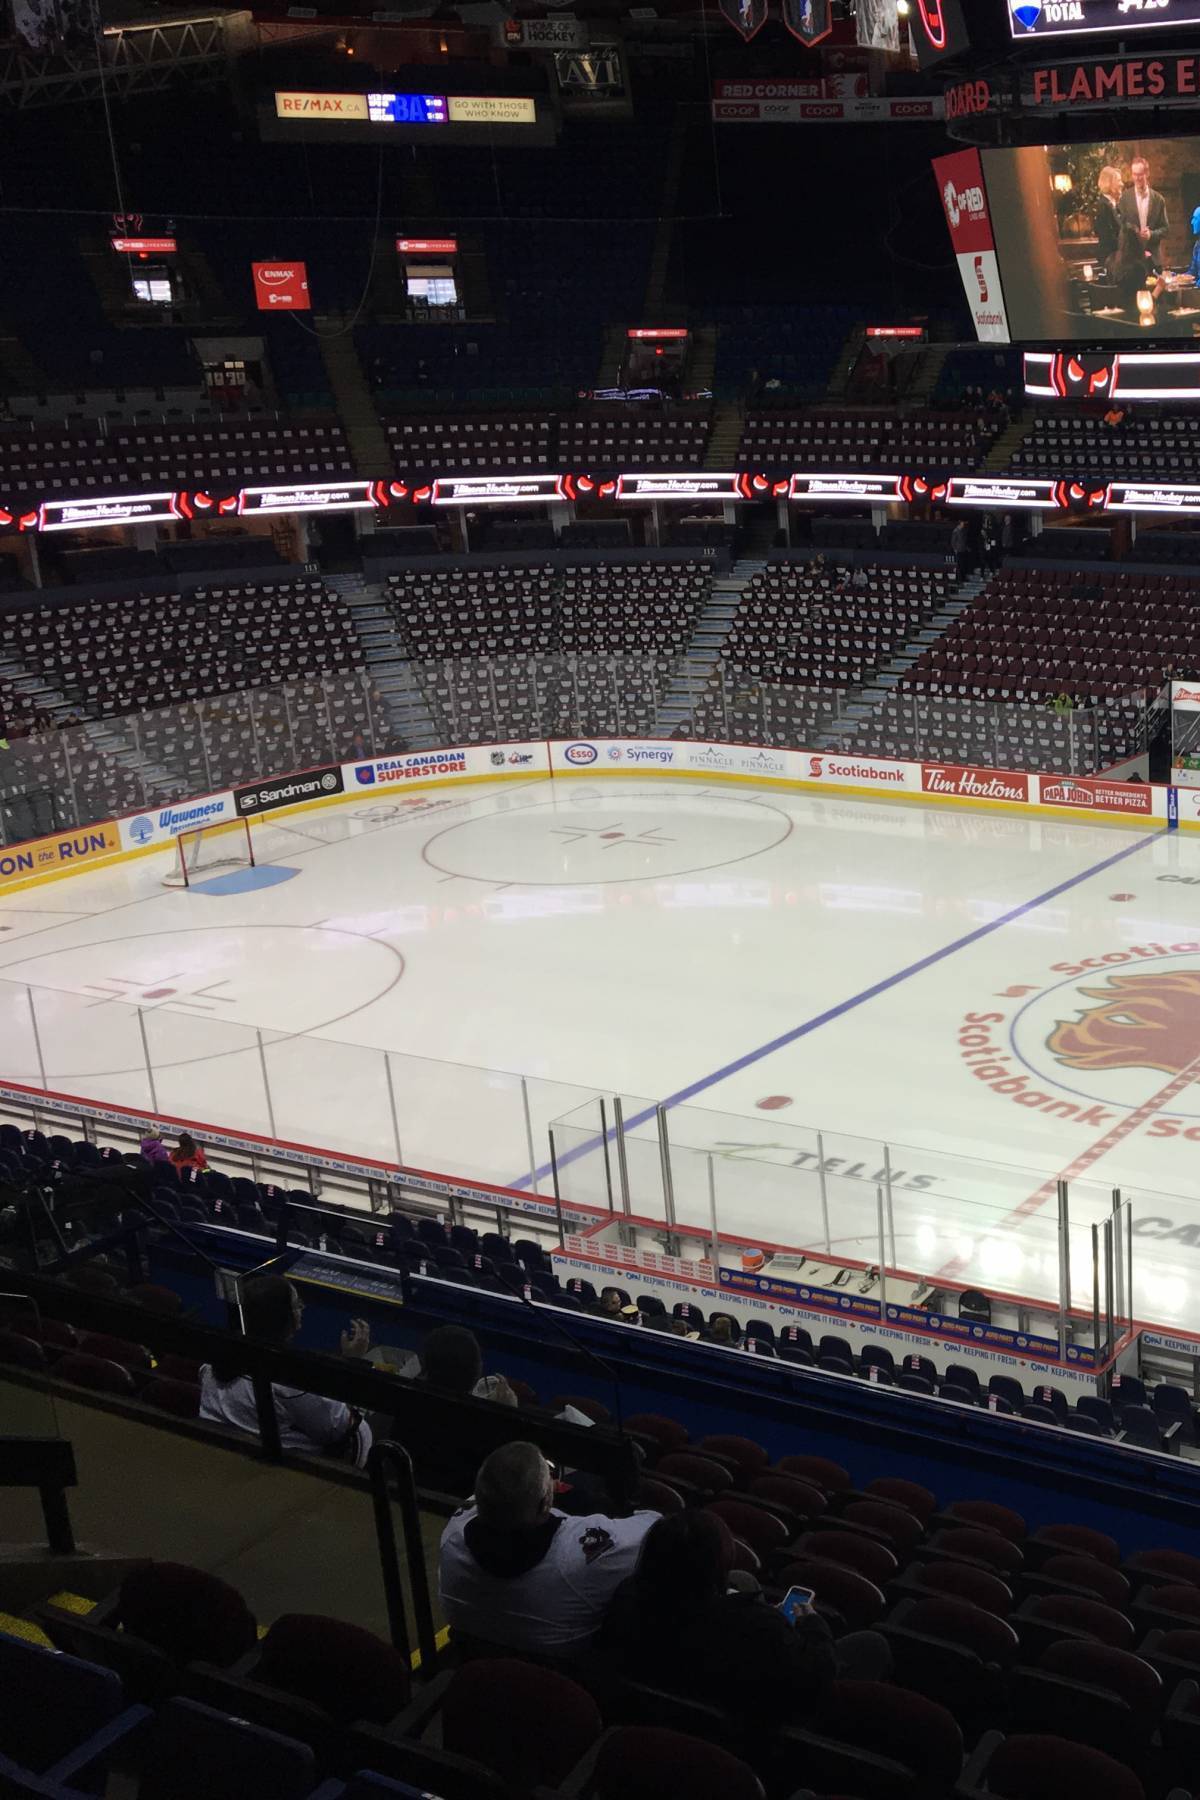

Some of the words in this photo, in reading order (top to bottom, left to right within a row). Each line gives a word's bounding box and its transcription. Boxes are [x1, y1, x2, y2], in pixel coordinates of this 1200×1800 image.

[1044, 4, 1084, 22] TOTAL
[529, 31, 575, 41] HOCKEY
[722, 84, 753, 97] RED
[756, 84, 818, 97] CORNER
[1033, 61, 1165, 104] FLAMES
[455, 101, 466, 109] GO
[471, 101, 495, 109] WITH
[499, 102, 528, 110] THOSE
[464, 109, 487, 117] WHO
[490, 110, 519, 118] KNOW
[966, 187, 984, 212] RED
[264, 270, 294, 278] ENMAX
[376, 759, 403, 772] REAL
[406, 752, 465, 767] CANADIAN
[570, 749, 594, 760] Esso
[627, 748, 673, 763] Synergy
[689, 755, 733, 766] PINNACLE
[378, 761, 467, 782] SUPERSTORE
[741, 760, 784, 771] PINNACLE
[828, 763, 904, 782] Scotiabank
[258, 780, 321, 804] Sandman
[924, 769, 954, 793] Tim
[958, 771, 1024, 800] Hortons
[1044, 788, 1065, 801] PAPA
[1095, 795, 1123, 806] BETTER
[160, 801, 225, 828] Wawanesa
[38, 849, 55, 862] the
[58, 832, 107, 860] RUN
[958, 1012, 1118, 1128] Scotiabank
[791, 1151, 940, 1190] TELUS
[963, 1346, 989, 1360] KEEPING
[990, 1353, 995, 1361] IT
[997, 1354, 1017, 1366] FRESH
